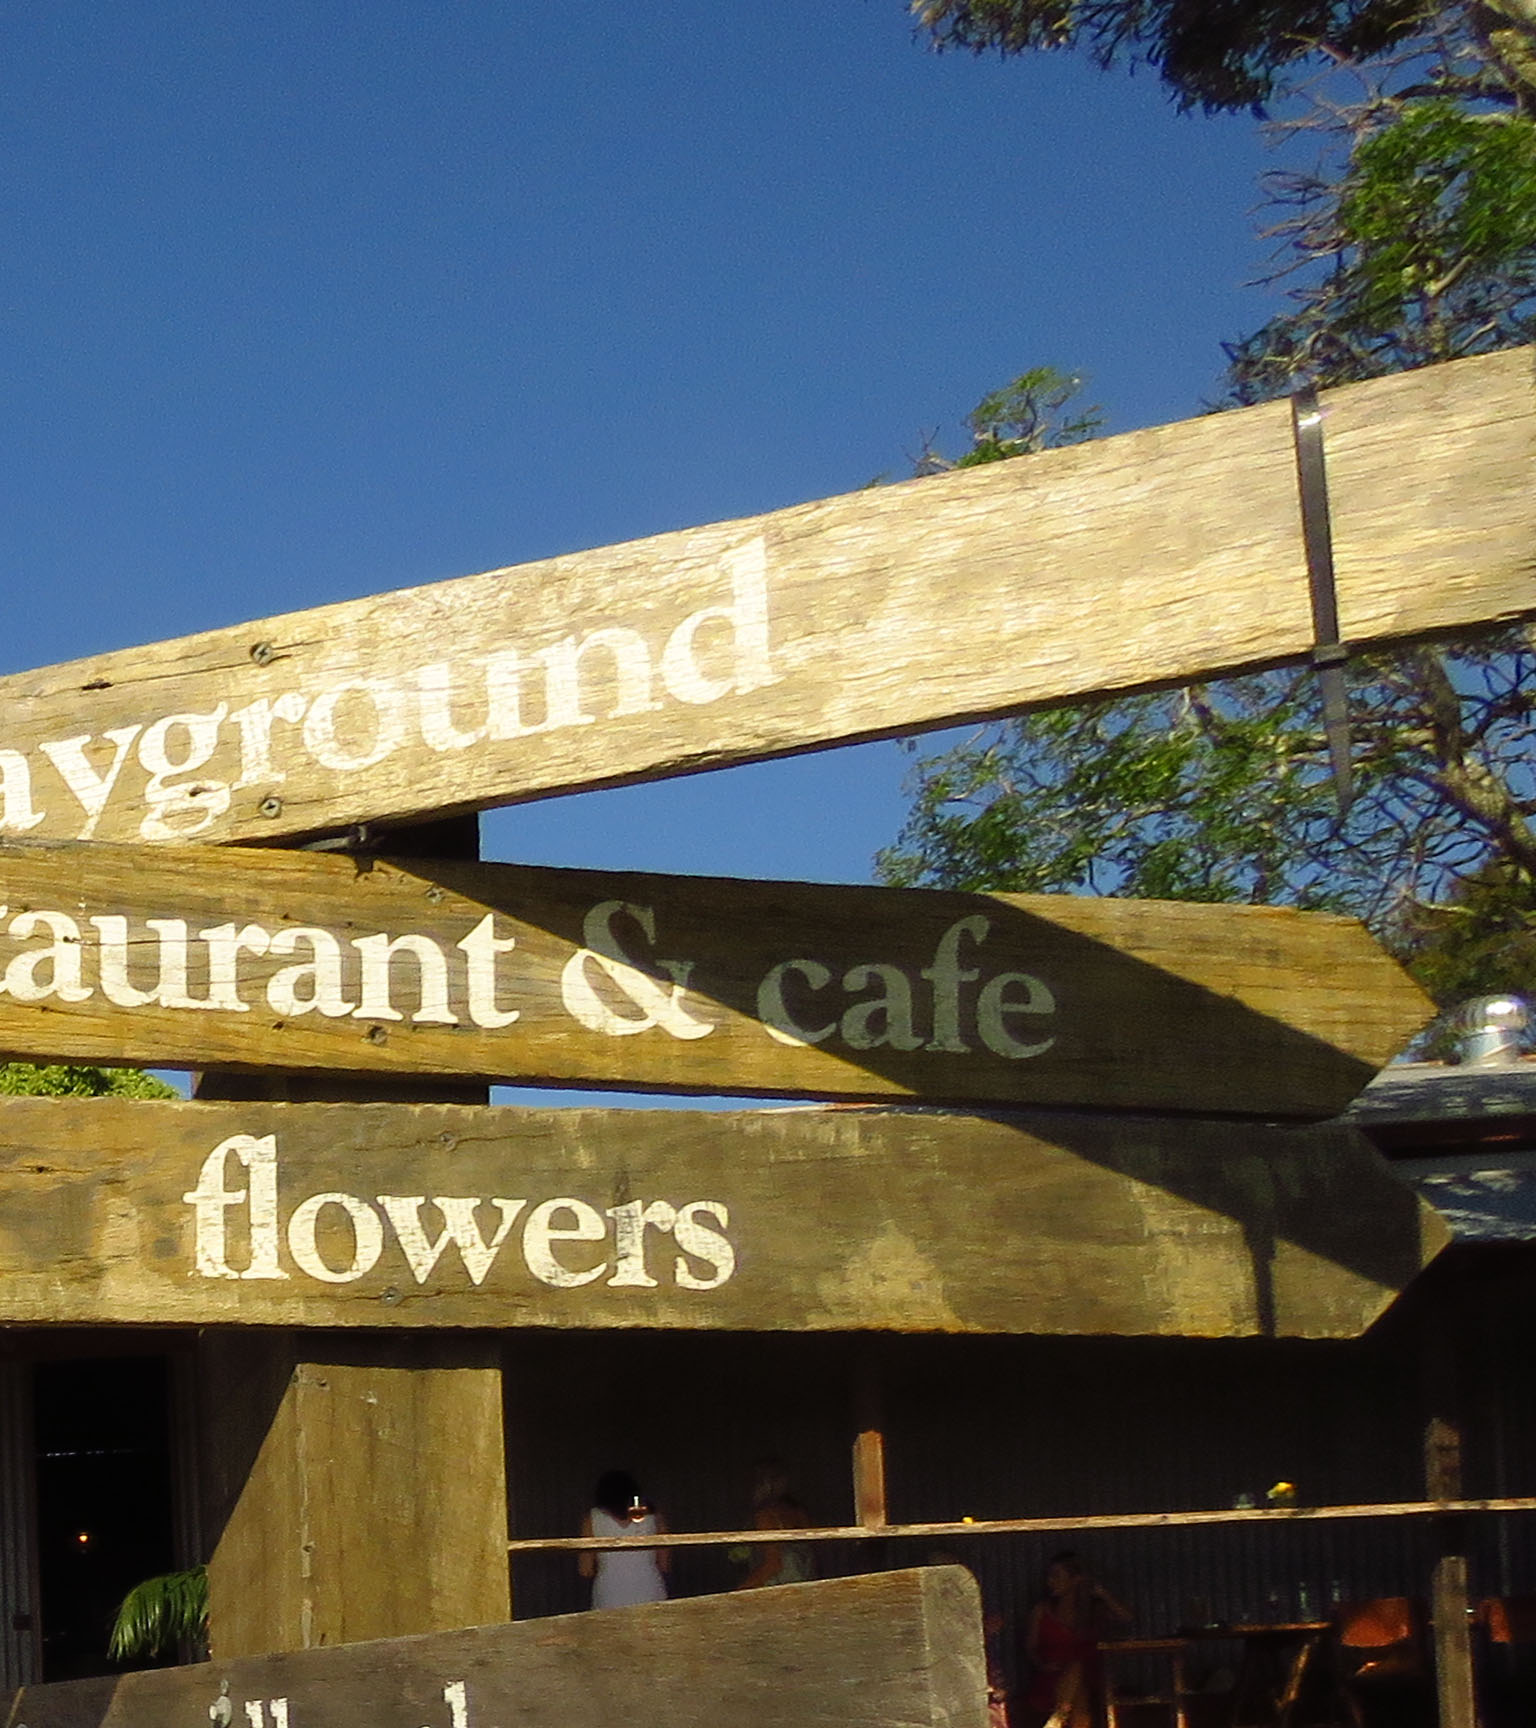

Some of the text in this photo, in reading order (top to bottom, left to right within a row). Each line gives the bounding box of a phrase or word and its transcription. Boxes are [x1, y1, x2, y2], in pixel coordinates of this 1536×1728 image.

[560, 898, 715, 1040] &
[756, 915, 1057, 1059] cafe
[183, 1134, 736, 1290] flowers
